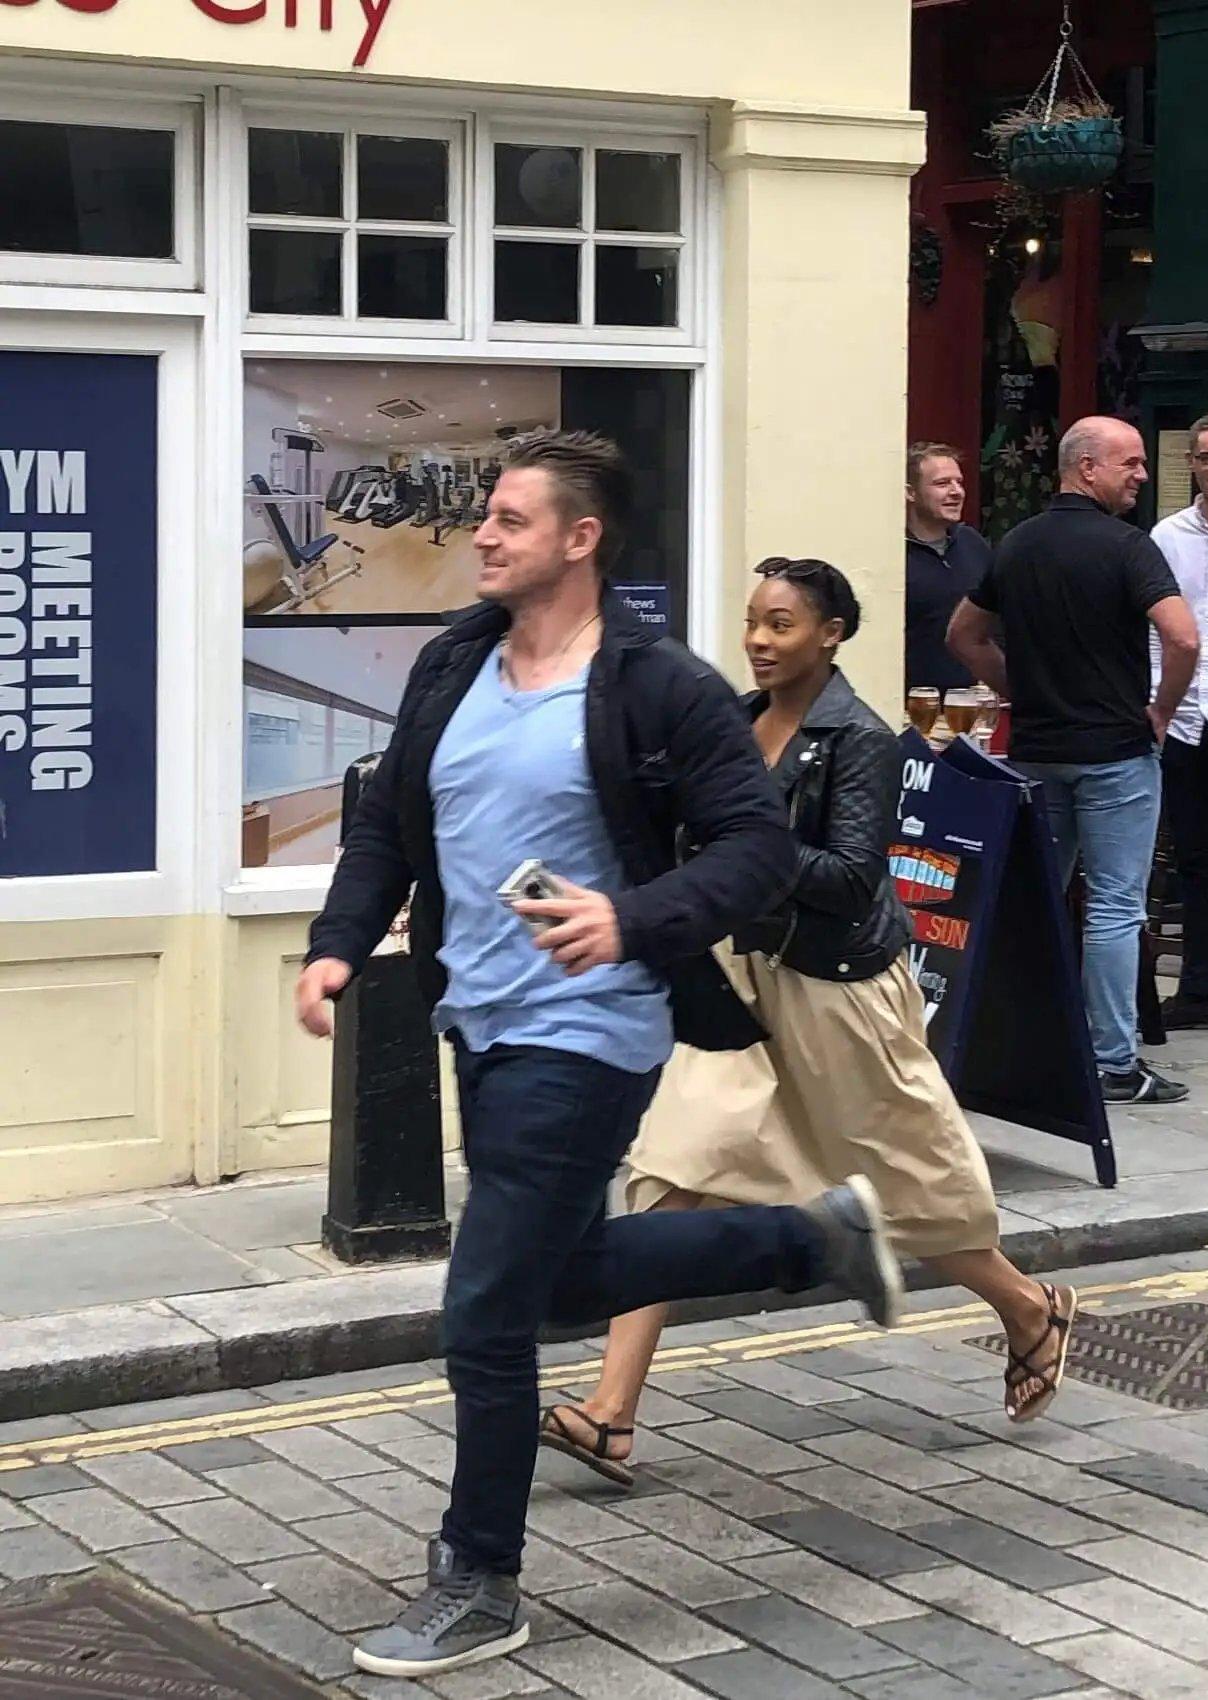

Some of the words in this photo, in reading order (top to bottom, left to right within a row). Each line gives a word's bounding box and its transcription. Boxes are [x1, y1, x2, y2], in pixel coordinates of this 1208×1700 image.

[622, 596, 656, 609] hews
[30, 531, 94, 791] MEETING
[925, 914, 970, 950] SUN
